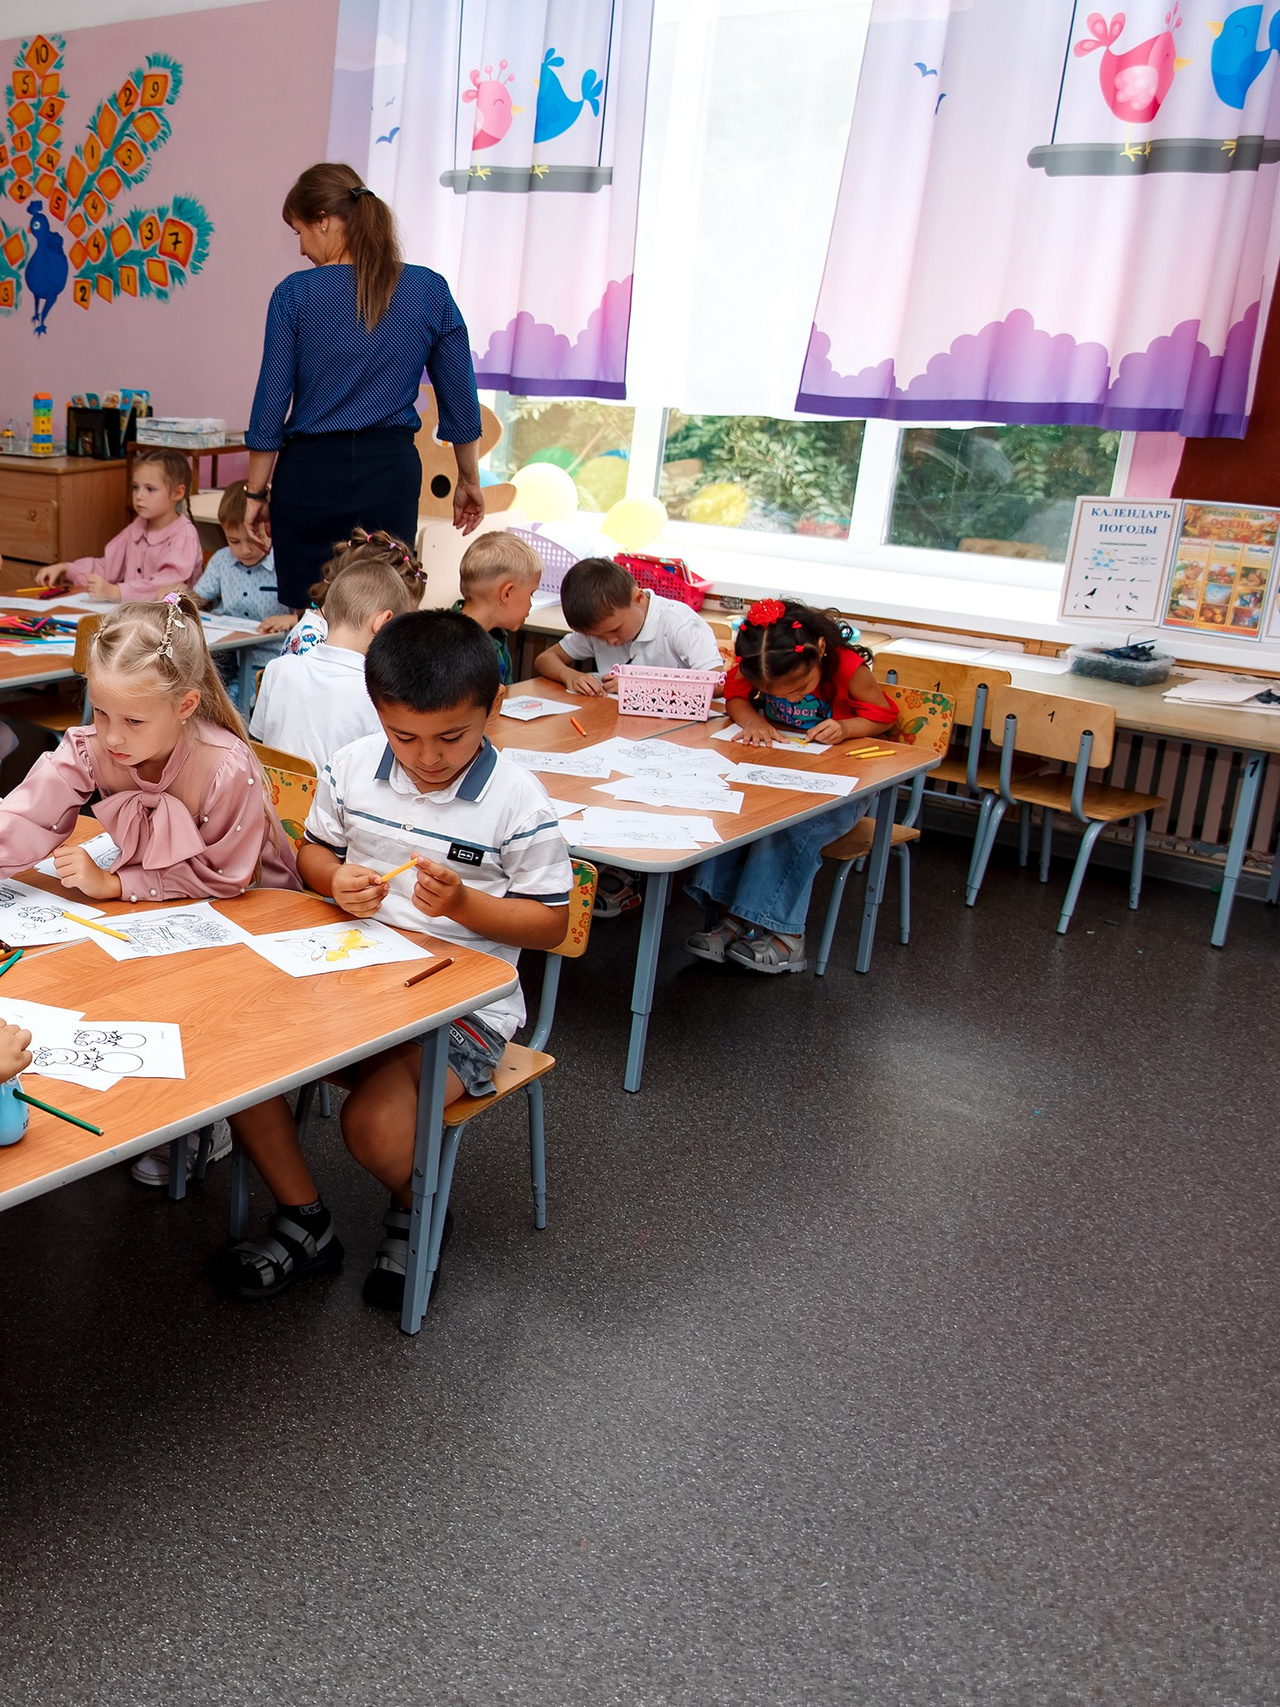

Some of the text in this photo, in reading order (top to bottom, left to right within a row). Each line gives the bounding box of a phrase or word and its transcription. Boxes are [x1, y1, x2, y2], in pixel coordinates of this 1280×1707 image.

[35, 44, 49, 65] 10
[22, 74, 30, 94] 5
[150, 82, 159, 98] 9
[123, 87, 134, 106] 2
[47, 103, 55, 118] 3
[46, 154, 55, 168] 4
[122, 149, 133, 167] 3
[17, 184, 25, 199] 2
[54, 197, 63, 211] 5
[91, 200, 99, 214] 4
[144, 222, 155, 241] 3
[93, 240, 101, 254] 4
[168, 231, 183, 251] 7
[2, 287, 10, 303] 3
[80, 285, 88, 302] 2
[1091, 507, 1171, 519] КАЛЕНДАРЬ
[1099, 523, 1158, 535] ПОГОДЫ
[933, 681, 941, 692] 1
[1048, 710, 1056, 723] 1
[1249, 758, 1261, 778] 1
